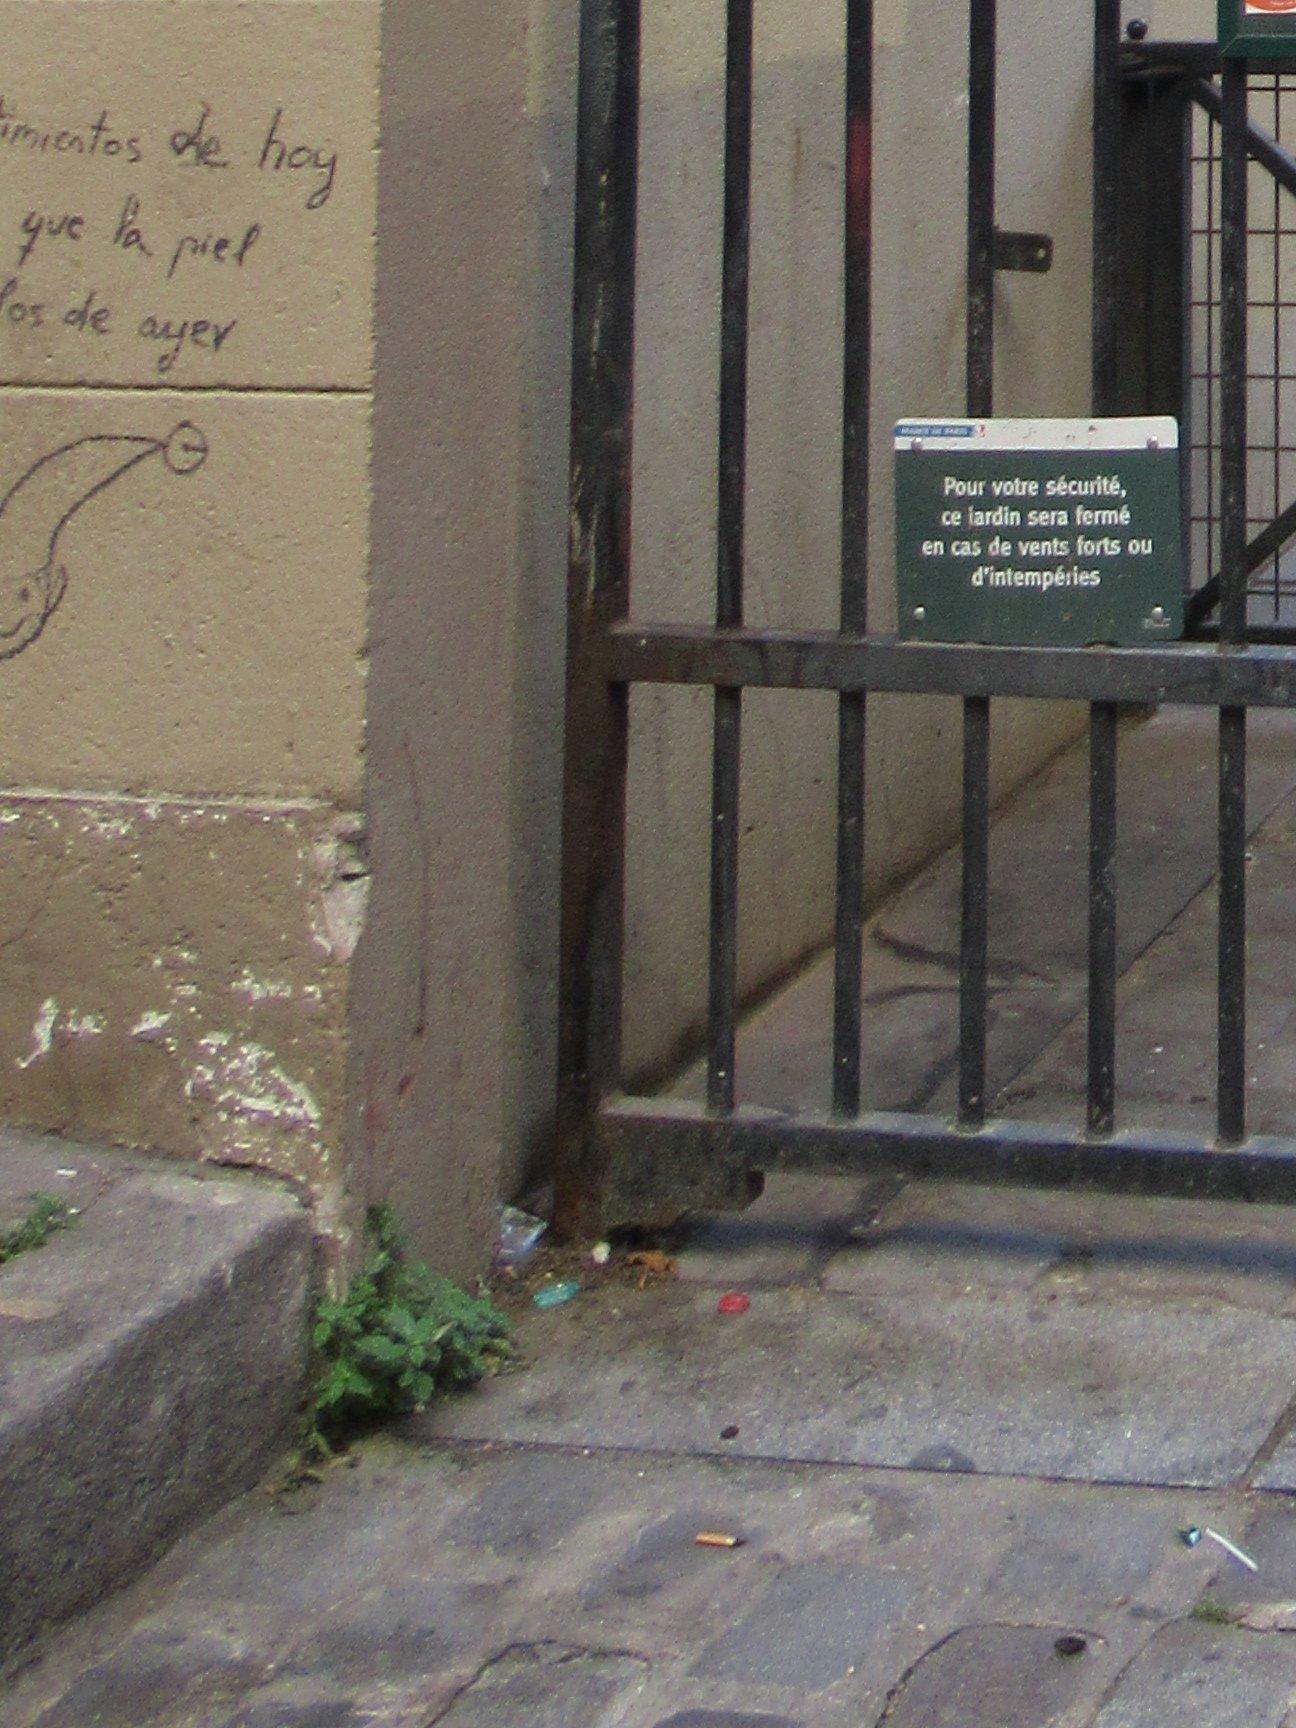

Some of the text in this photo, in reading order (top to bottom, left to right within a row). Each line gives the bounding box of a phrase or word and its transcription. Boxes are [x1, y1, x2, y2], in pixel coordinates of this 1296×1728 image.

[258, 108, 337, 210] hoy
[944, 476, 1126, 498] Pour votre sécurité,
[942, 511, 962, 526] ce
[1027, 510, 1068, 525] sera
[1074, 504, 1131, 525] fermé
[922, 536, 1153, 556] en cas de vents forts ou
[971, 565, 1101, 591] d'intempéries
